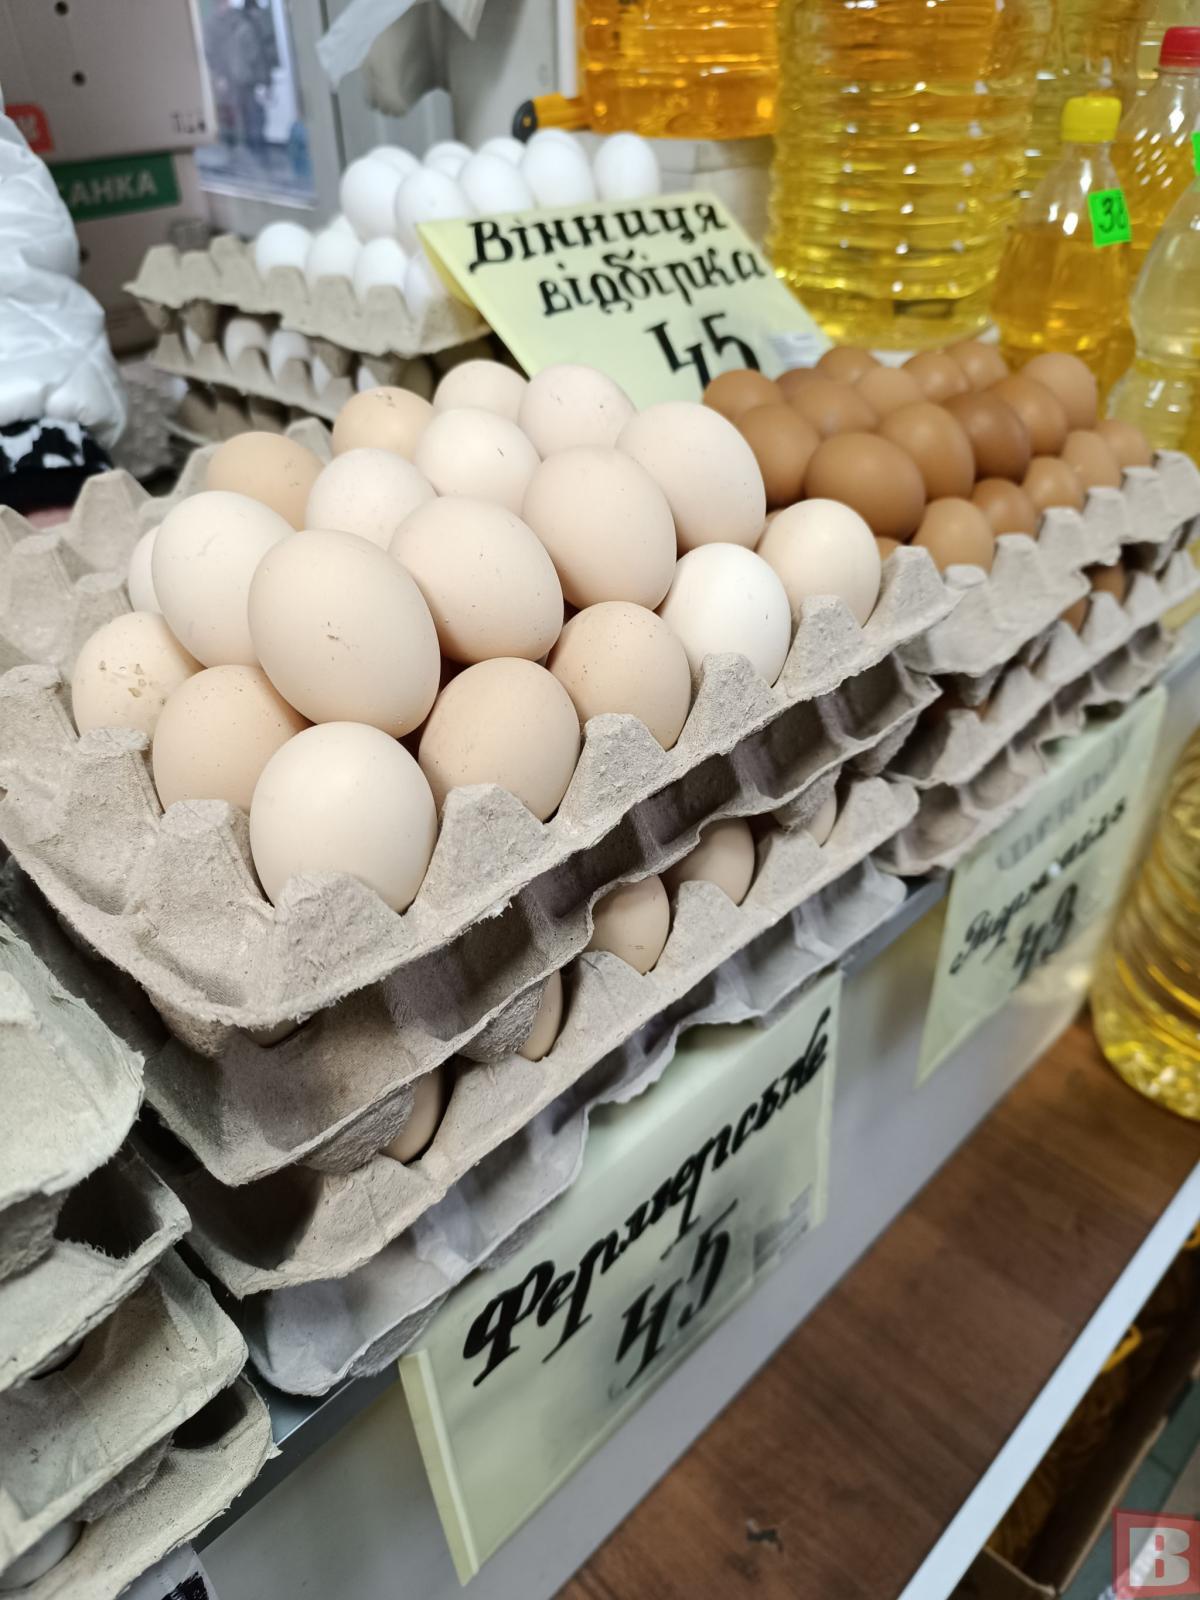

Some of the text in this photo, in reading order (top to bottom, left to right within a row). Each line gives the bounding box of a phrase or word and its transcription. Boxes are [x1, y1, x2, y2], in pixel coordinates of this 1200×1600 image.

[60, 169, 159, 207] АНКА
[467, 202, 727, 274] Вінниця
[537, 246, 767, 317] відбірка
[645, 313, 761, 391] 45
[616, 1199, 738, 1389] 45
